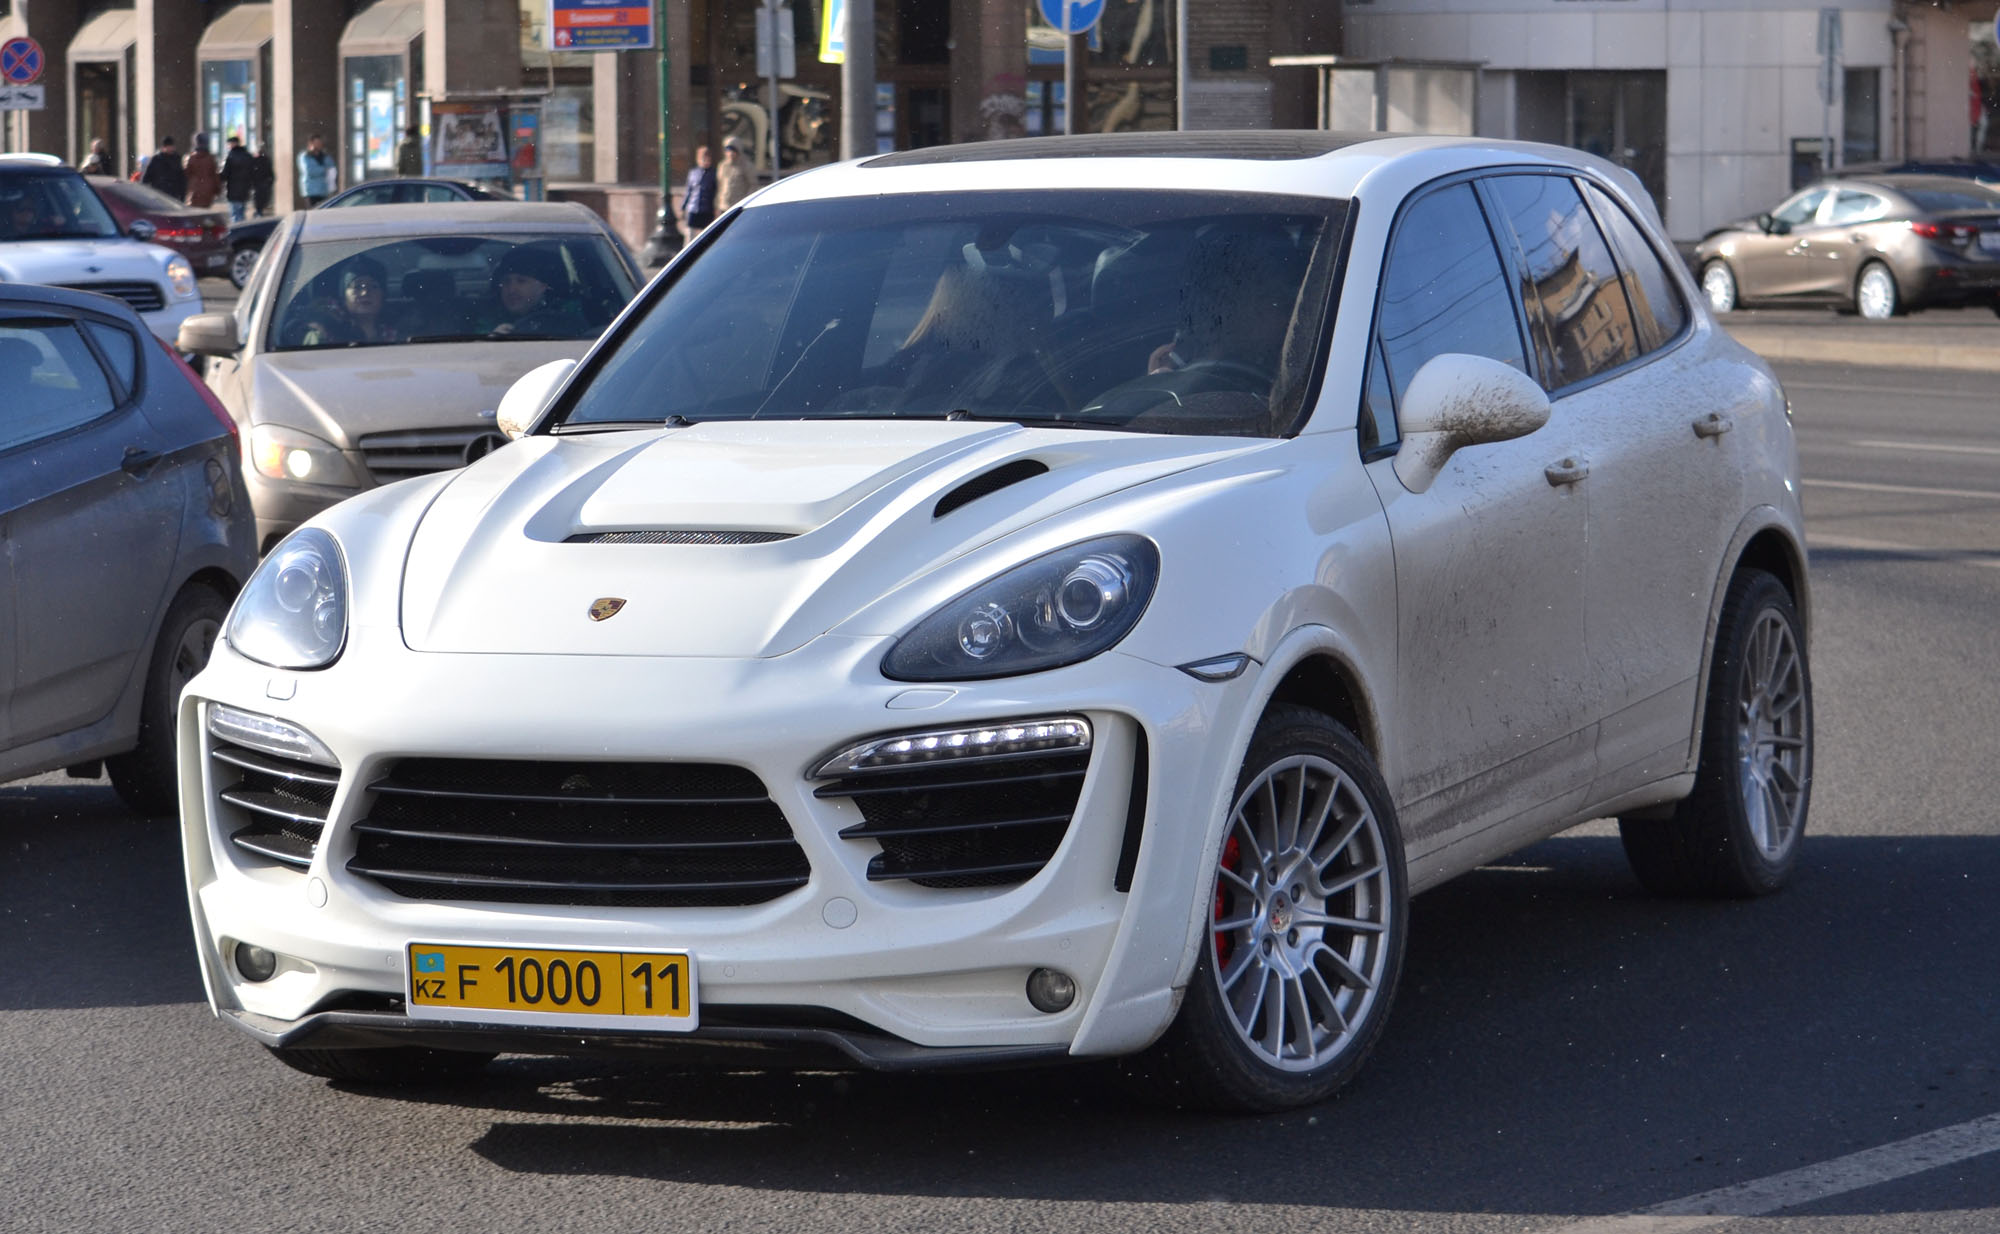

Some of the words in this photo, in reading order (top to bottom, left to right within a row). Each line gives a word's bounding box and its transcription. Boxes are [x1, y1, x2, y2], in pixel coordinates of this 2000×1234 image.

[415, 979, 446, 999] KZ
[458, 965, 480, 1000] F
[494, 956, 601, 1007] 1000
[631, 962, 680, 1010] 11
